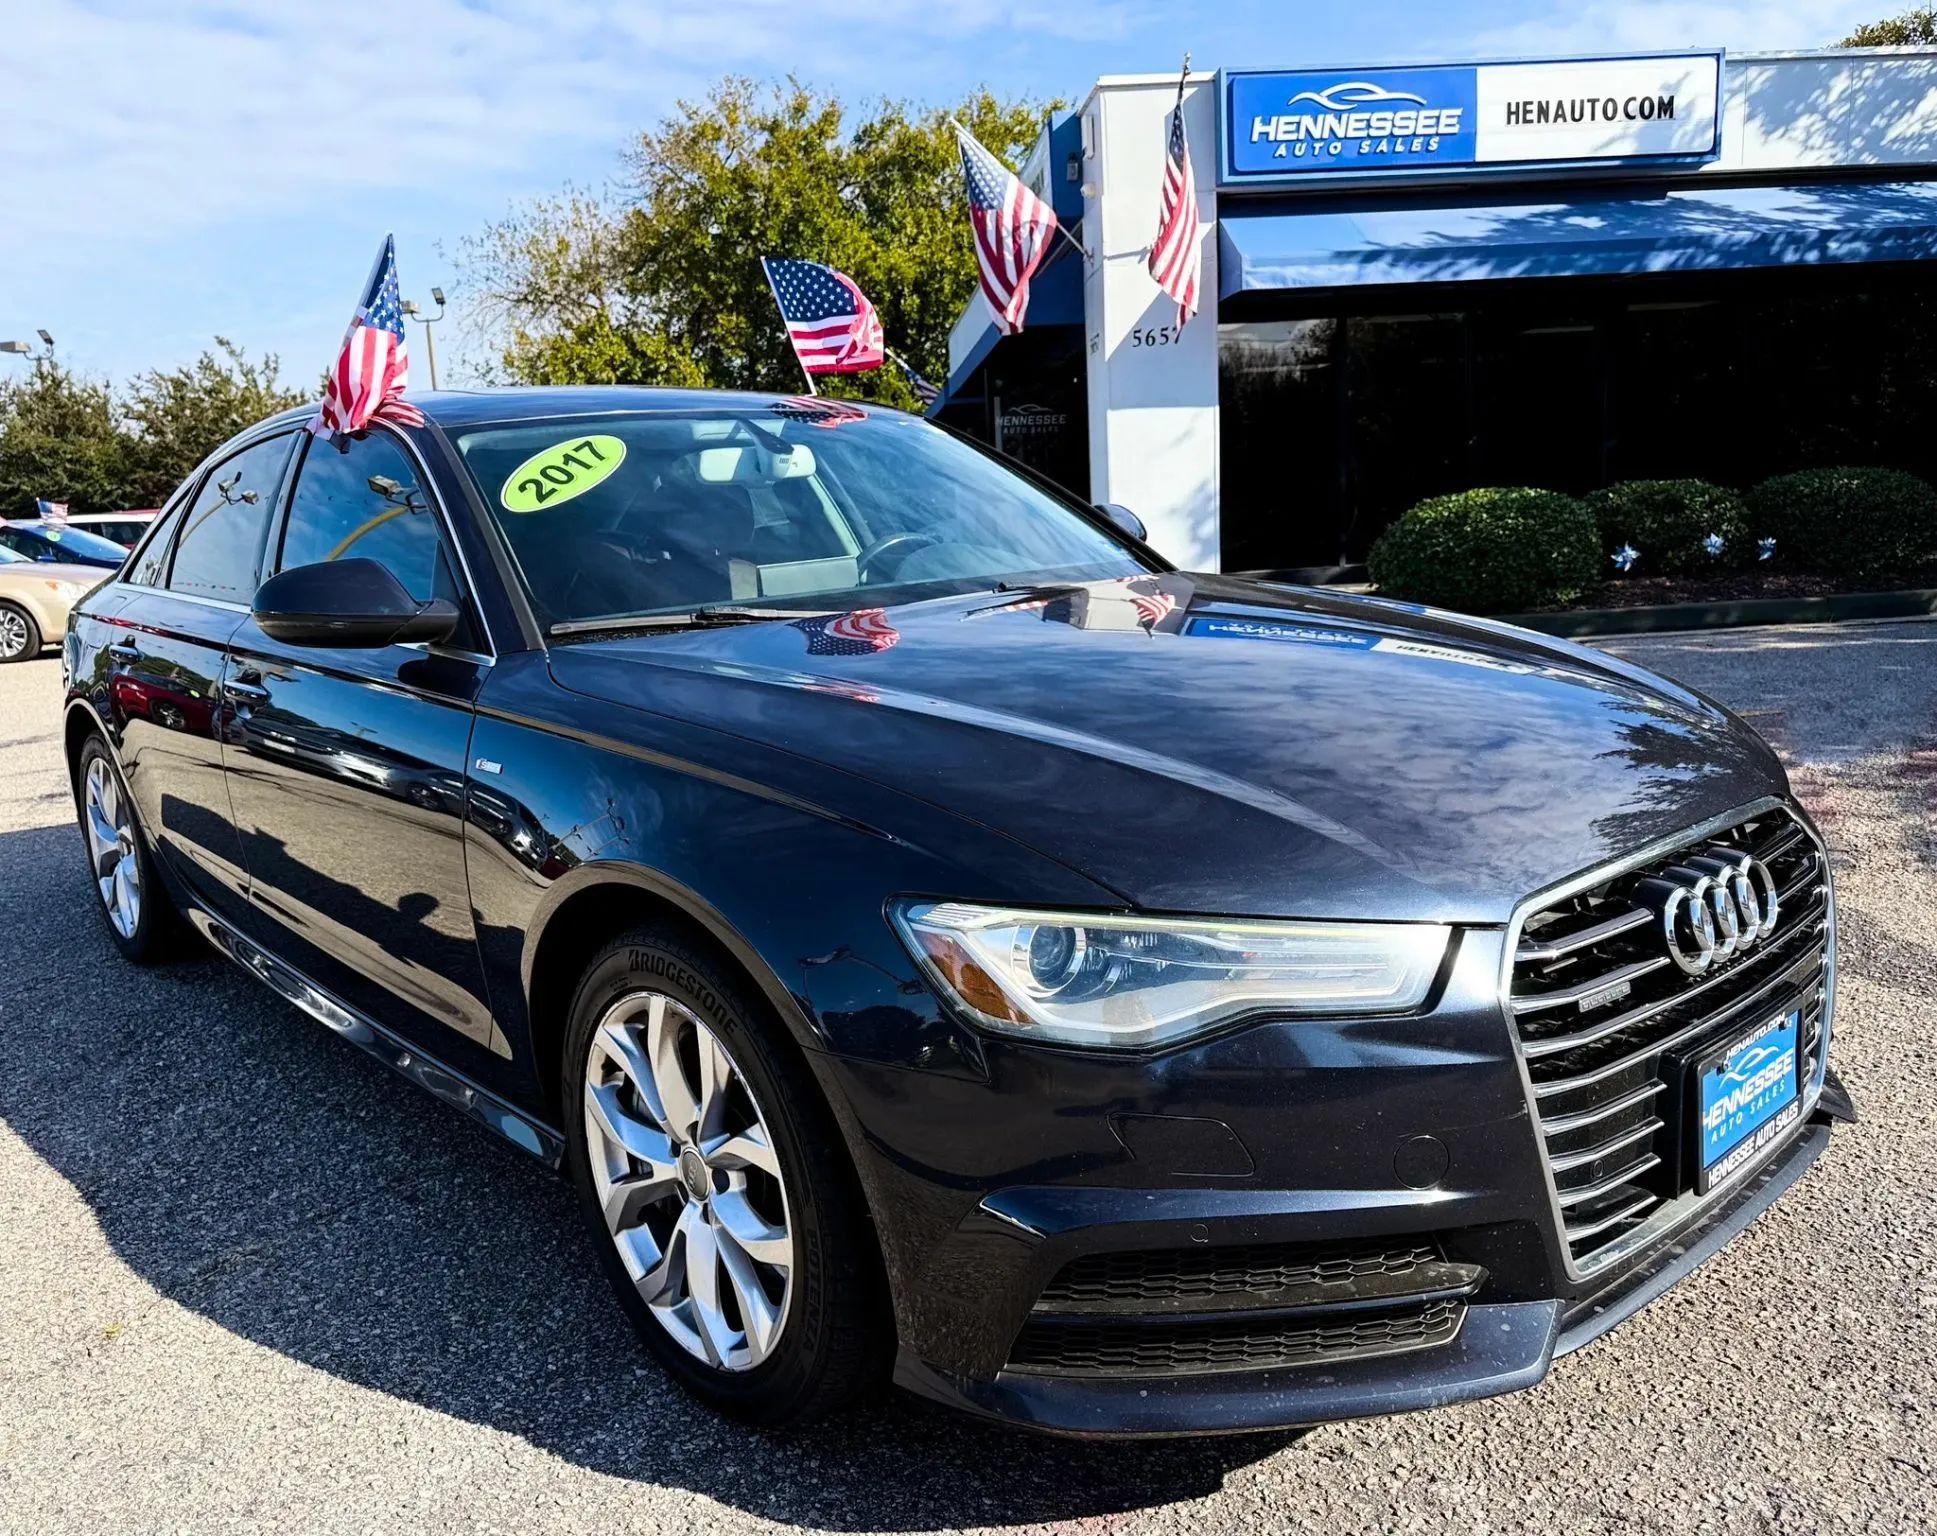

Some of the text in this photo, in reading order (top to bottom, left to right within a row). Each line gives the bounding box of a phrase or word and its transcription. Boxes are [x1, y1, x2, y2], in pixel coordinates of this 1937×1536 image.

[1250, 107, 1463, 142] HENNESSEE
[1273, 136, 1439, 158] AUTO SALES
[1132, 326, 1182, 348] 5657
[994, 413, 1068, 426] HENNESSEE
[1003, 425, 1059, 435] AUTO SALES
[518, 440, 606, 504] 2017
[628, 949, 739, 1037] BRIDGESTONE
[1724, 1011, 1786, 1062] HENAUTO.COM
[1702, 1047, 1794, 1131] HENNESSEE
[1711, 1079, 1786, 1145] AUTO SALES
[1708, 1100, 1799, 1189] HENNESSEE AUTO SALES
